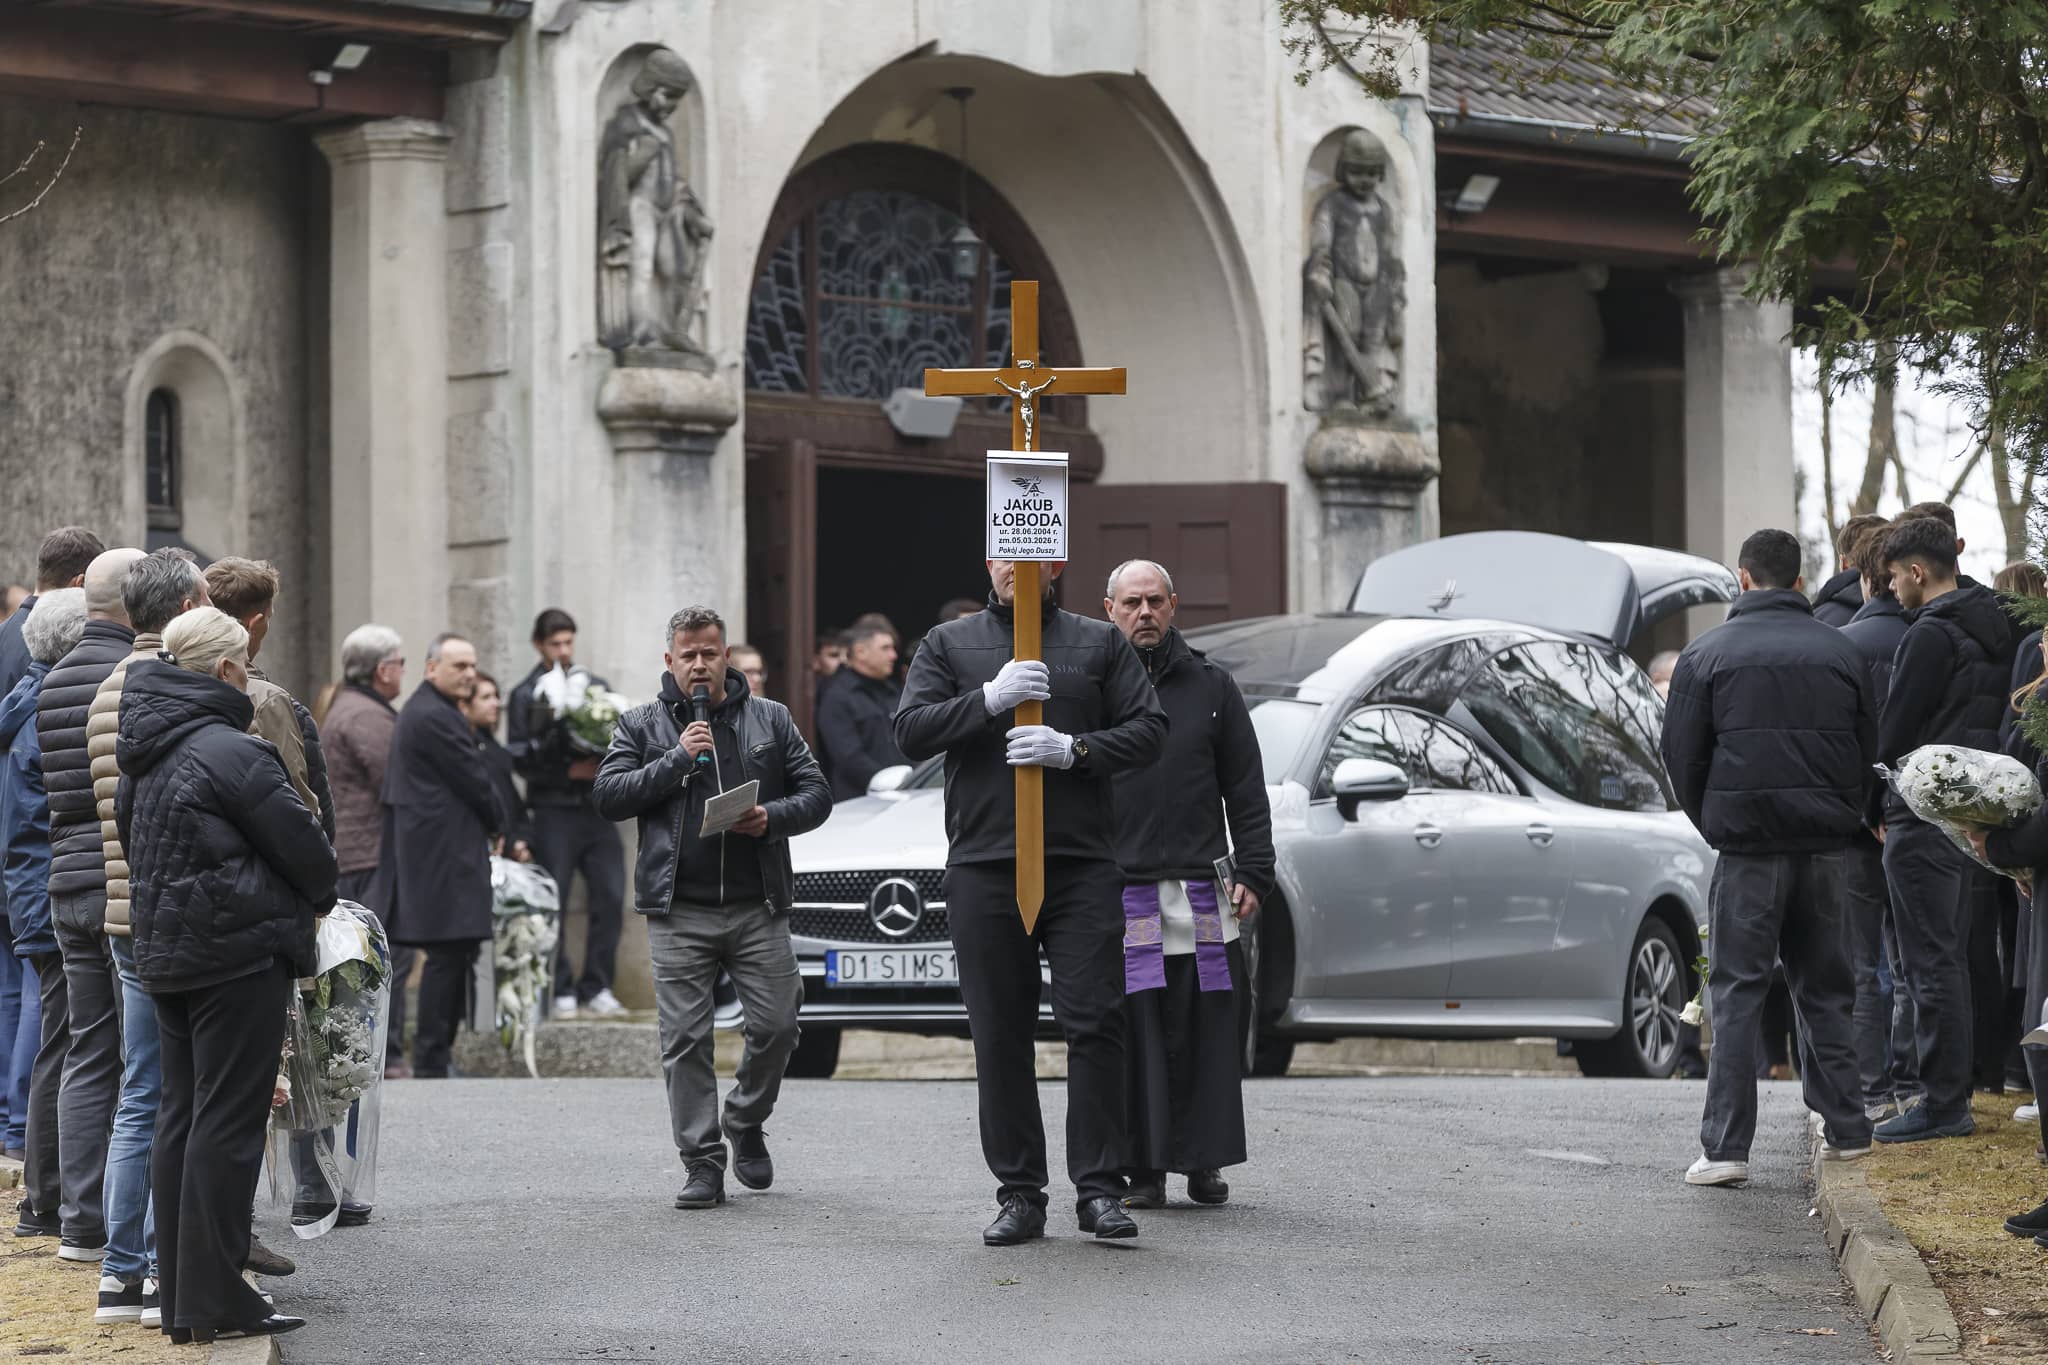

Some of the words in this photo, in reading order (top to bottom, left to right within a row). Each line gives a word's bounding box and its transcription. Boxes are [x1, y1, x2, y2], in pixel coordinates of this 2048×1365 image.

[1003, 499, 1053, 511] JAKUB
[992, 513, 1062, 526] ŁOBODA
[998, 546, 1018, 554] Pokój
[1018, 547, 1035, 555] Jego
[1035, 547, 1057, 555] Duszy
[841, 954, 868, 979] D1
[880, 953, 958, 979] SIMS1
